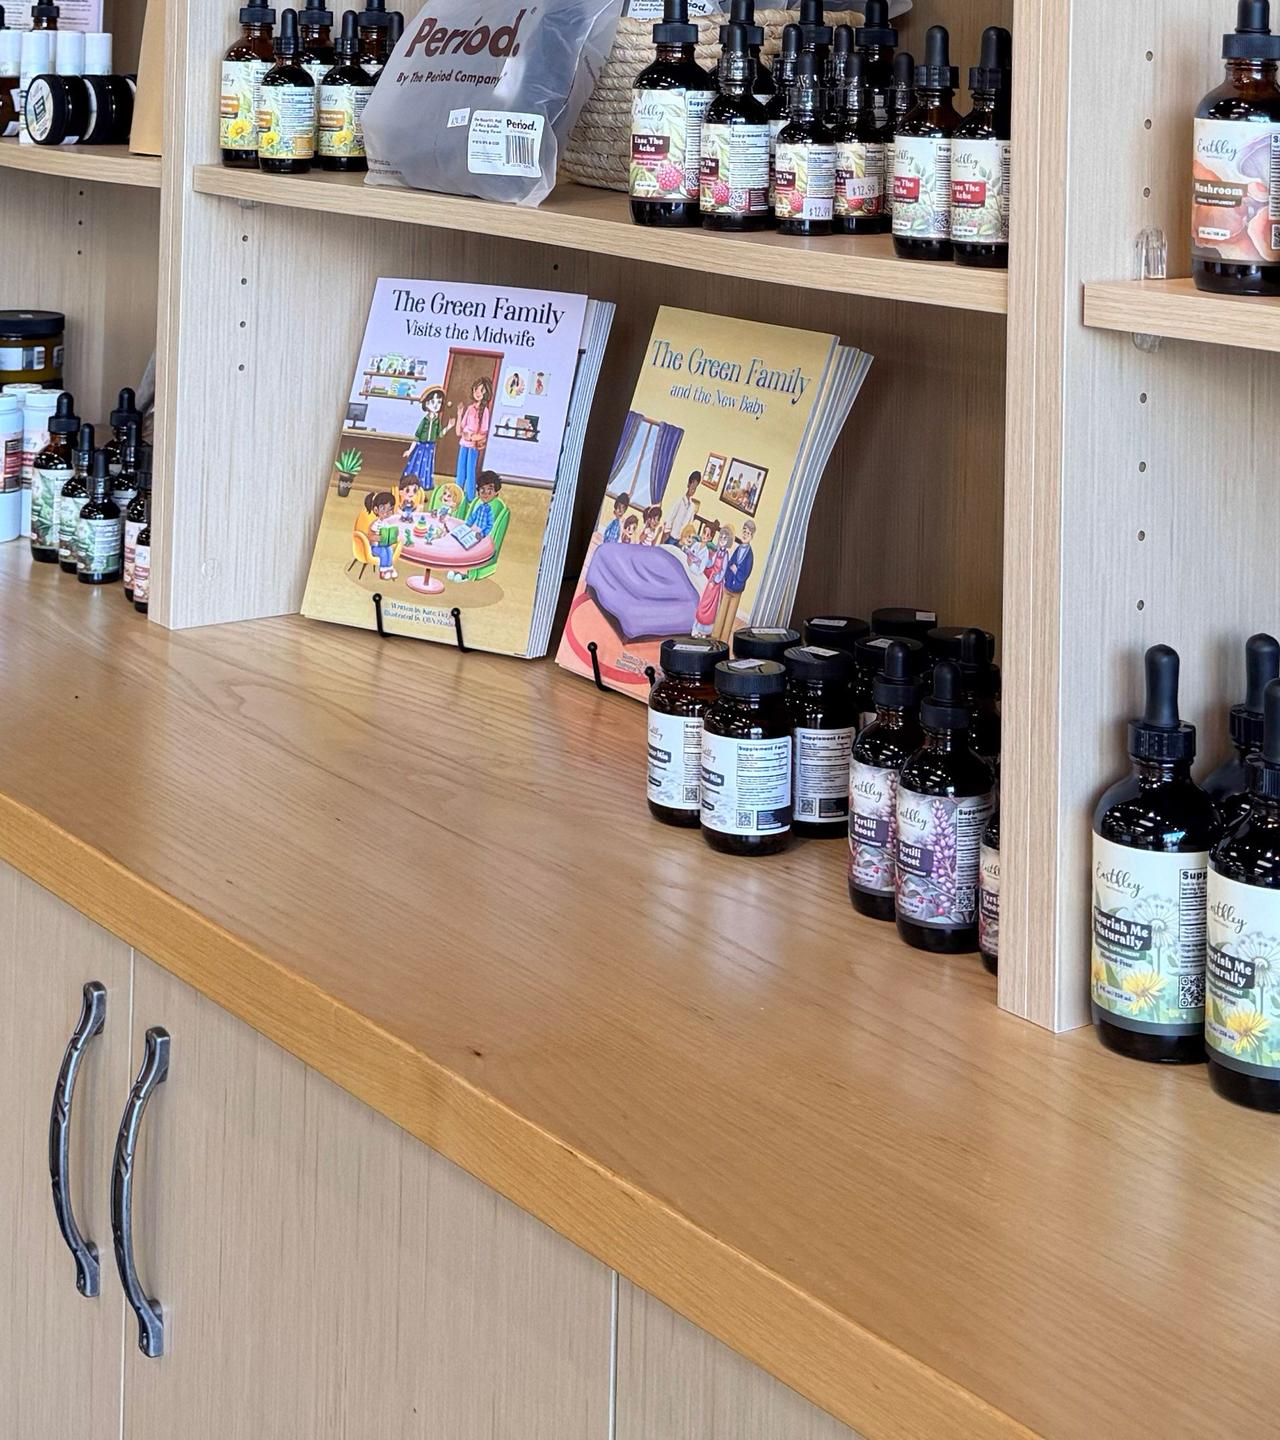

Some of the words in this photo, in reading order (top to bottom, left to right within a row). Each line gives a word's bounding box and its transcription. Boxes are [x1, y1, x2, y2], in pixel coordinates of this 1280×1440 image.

[404, 8, 528, 58] Period.
[396, 72, 408, 86] By
[410, 72, 423, 83] The
[425, 69, 453, 83] Period
[455, 71, 502, 88] Company
[506, 118, 537, 131] Period.
[649, 137, 663, 145] The
[852, 184, 875, 196] $12.99
[901, 180, 914, 188] The
[965, 184, 980, 192] The
[1195, 183, 1242, 196] Mushroom
[392, 289, 426, 313] The
[430, 292, 486, 318] Green
[492, 297, 566, 334] Family
[405, 319, 442, 338] Visits
[445, 323, 469, 340] the
[472, 324, 536, 348] Midwife
[652, 340, 683, 371] The
[688, 347, 742, 383] Green
[745, 357, 812, 405] Family
[670, 383, 691, 399] and
[693, 386, 711, 405] the
[713, 389, 737, 408] New
[739, 395, 766, 420] Baby
[1096, 922, 1143, 950] Naturally
[1130, 926, 1149, 938] Me
[1234, 961, 1252, 976] Me
